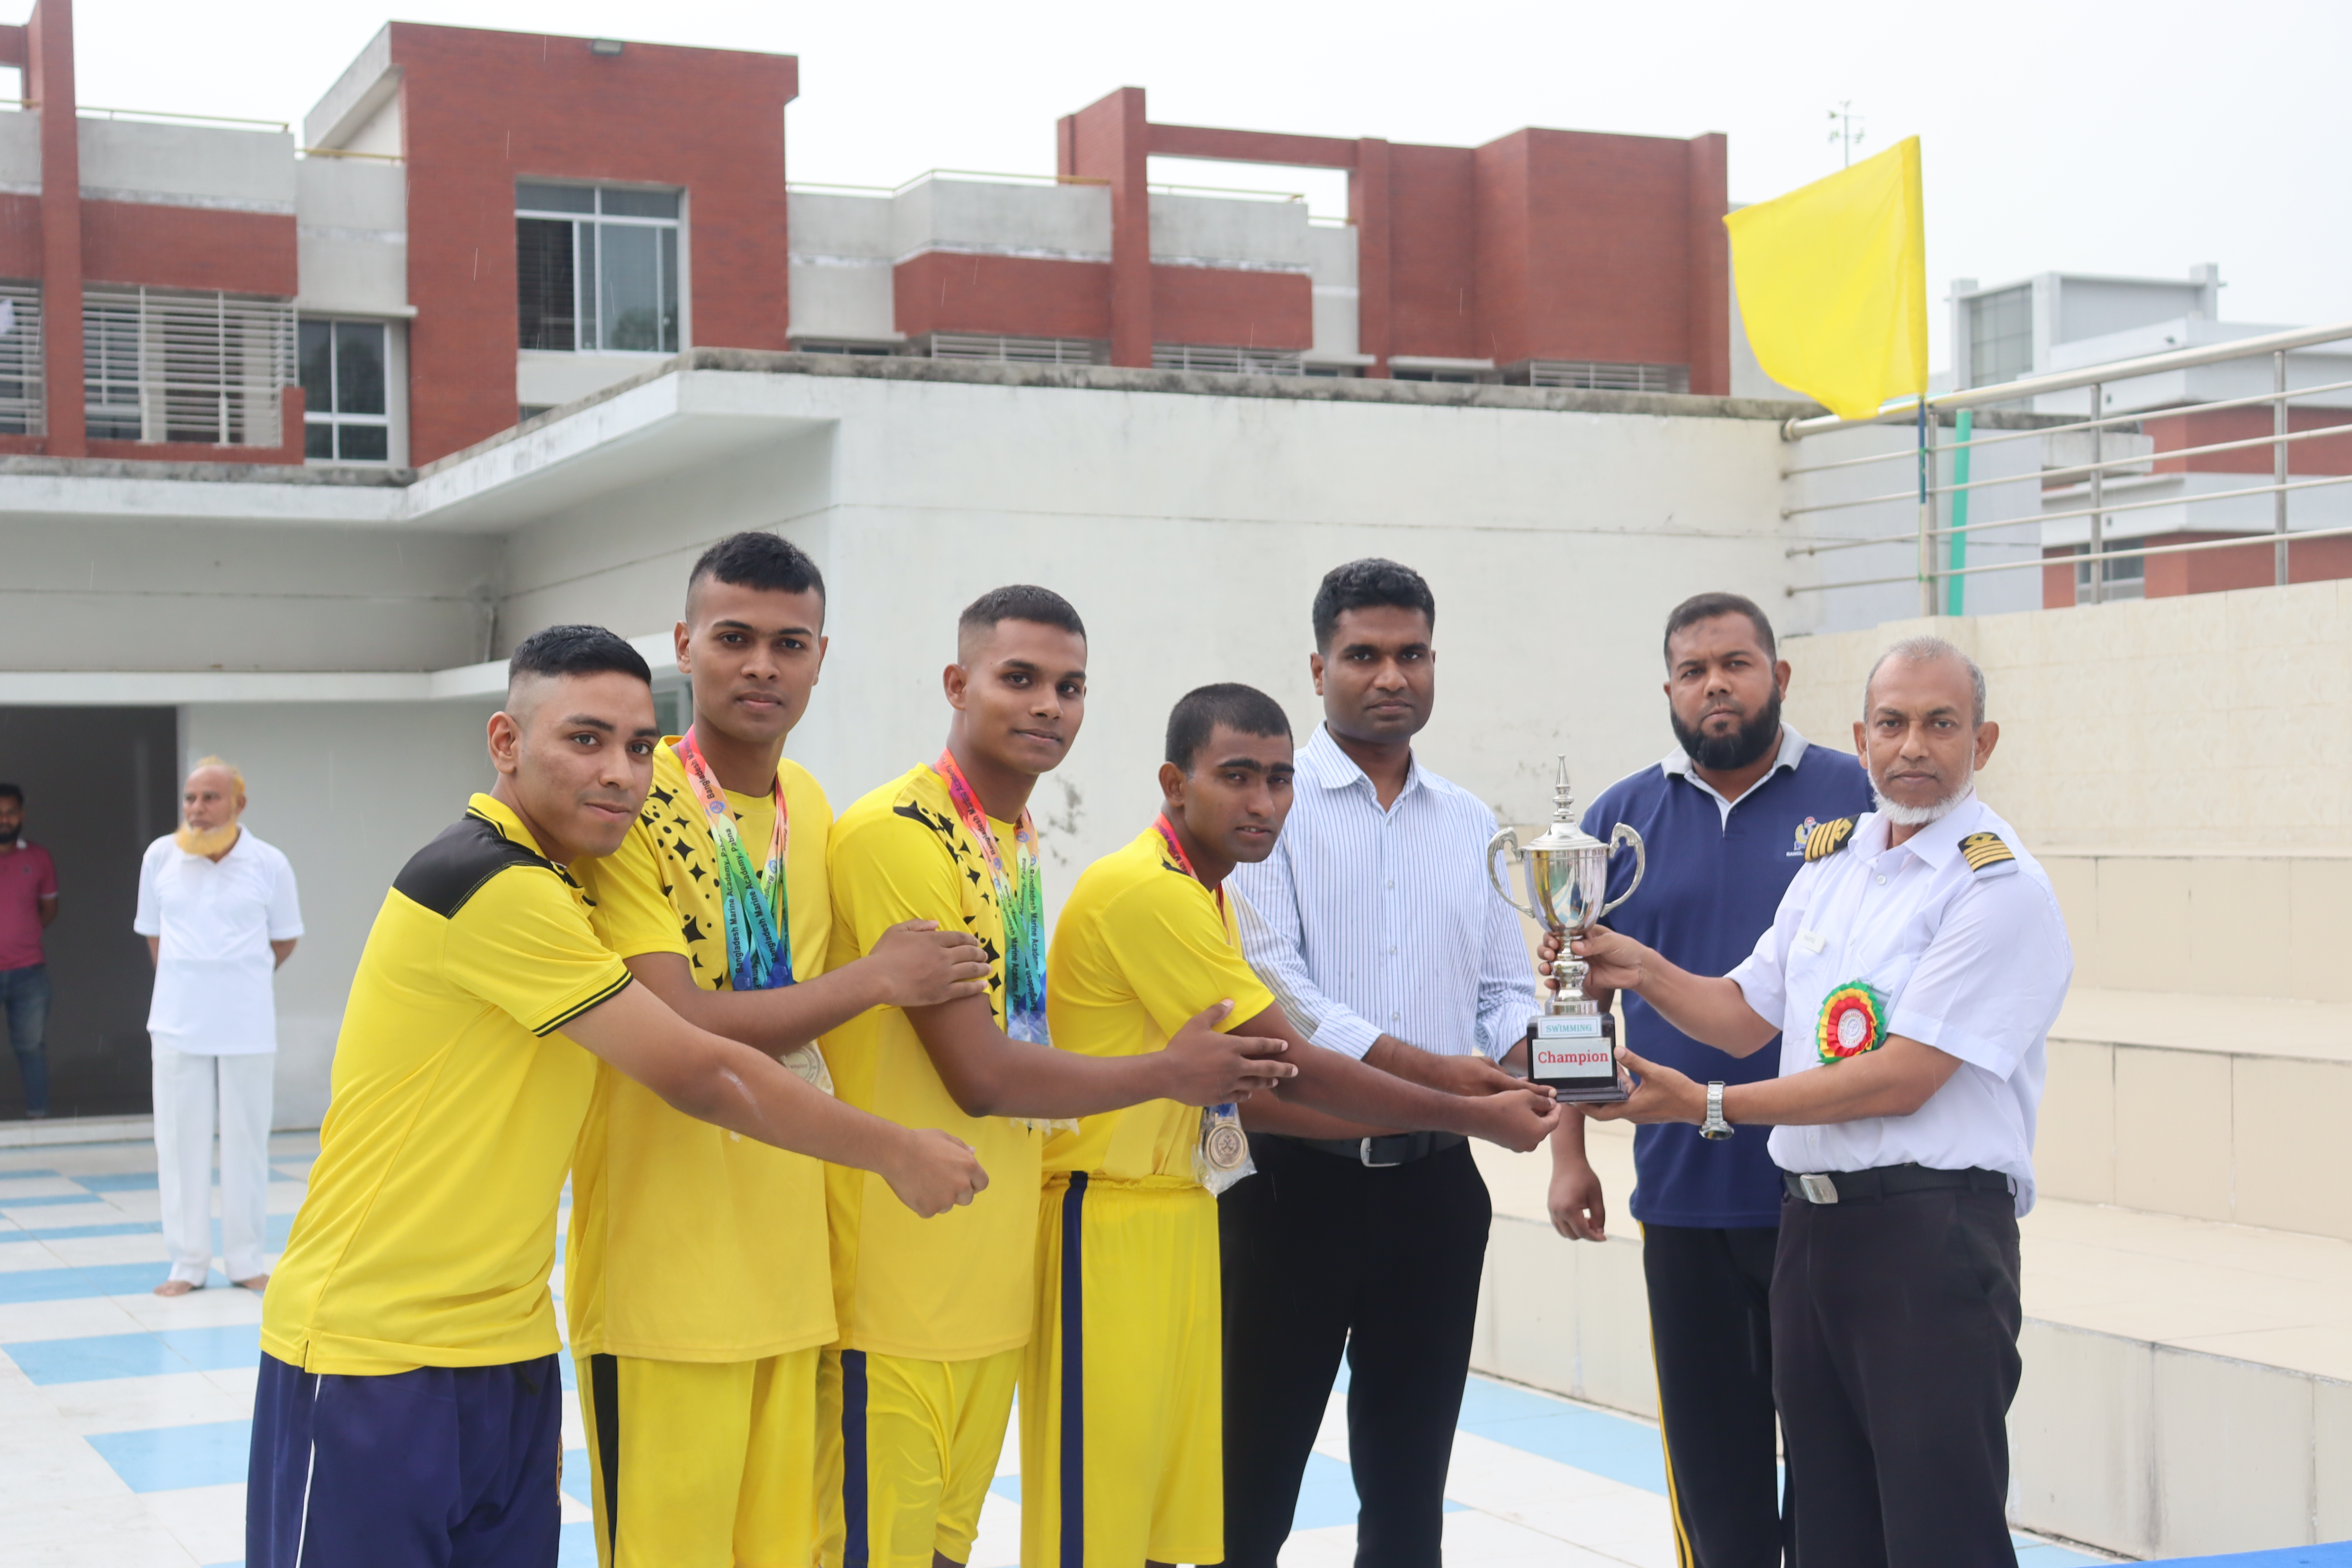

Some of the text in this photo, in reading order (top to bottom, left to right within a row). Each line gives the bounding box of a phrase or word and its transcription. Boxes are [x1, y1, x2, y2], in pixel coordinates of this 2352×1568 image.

[691, 759, 715, 799] Bangladesh
[961, 791, 976, 815] Marine
[726, 828, 738, 852] Pabna
[973, 815, 996, 855] Bangladesh
[737, 853, 753, 889] Academy,
[764, 875, 774, 899] Bangla
[728, 899, 737, 925] Marine
[750, 891, 763, 917] Marine
[731, 927, 743, 973] Bangladesh
[759, 918, 779, 962] Bangladesh
[1025, 970, 1038, 1011] Bangladesh
[1546, 1024, 1592, 1033] SWIMMING
[1538, 1050, 1608, 1065] Champion
